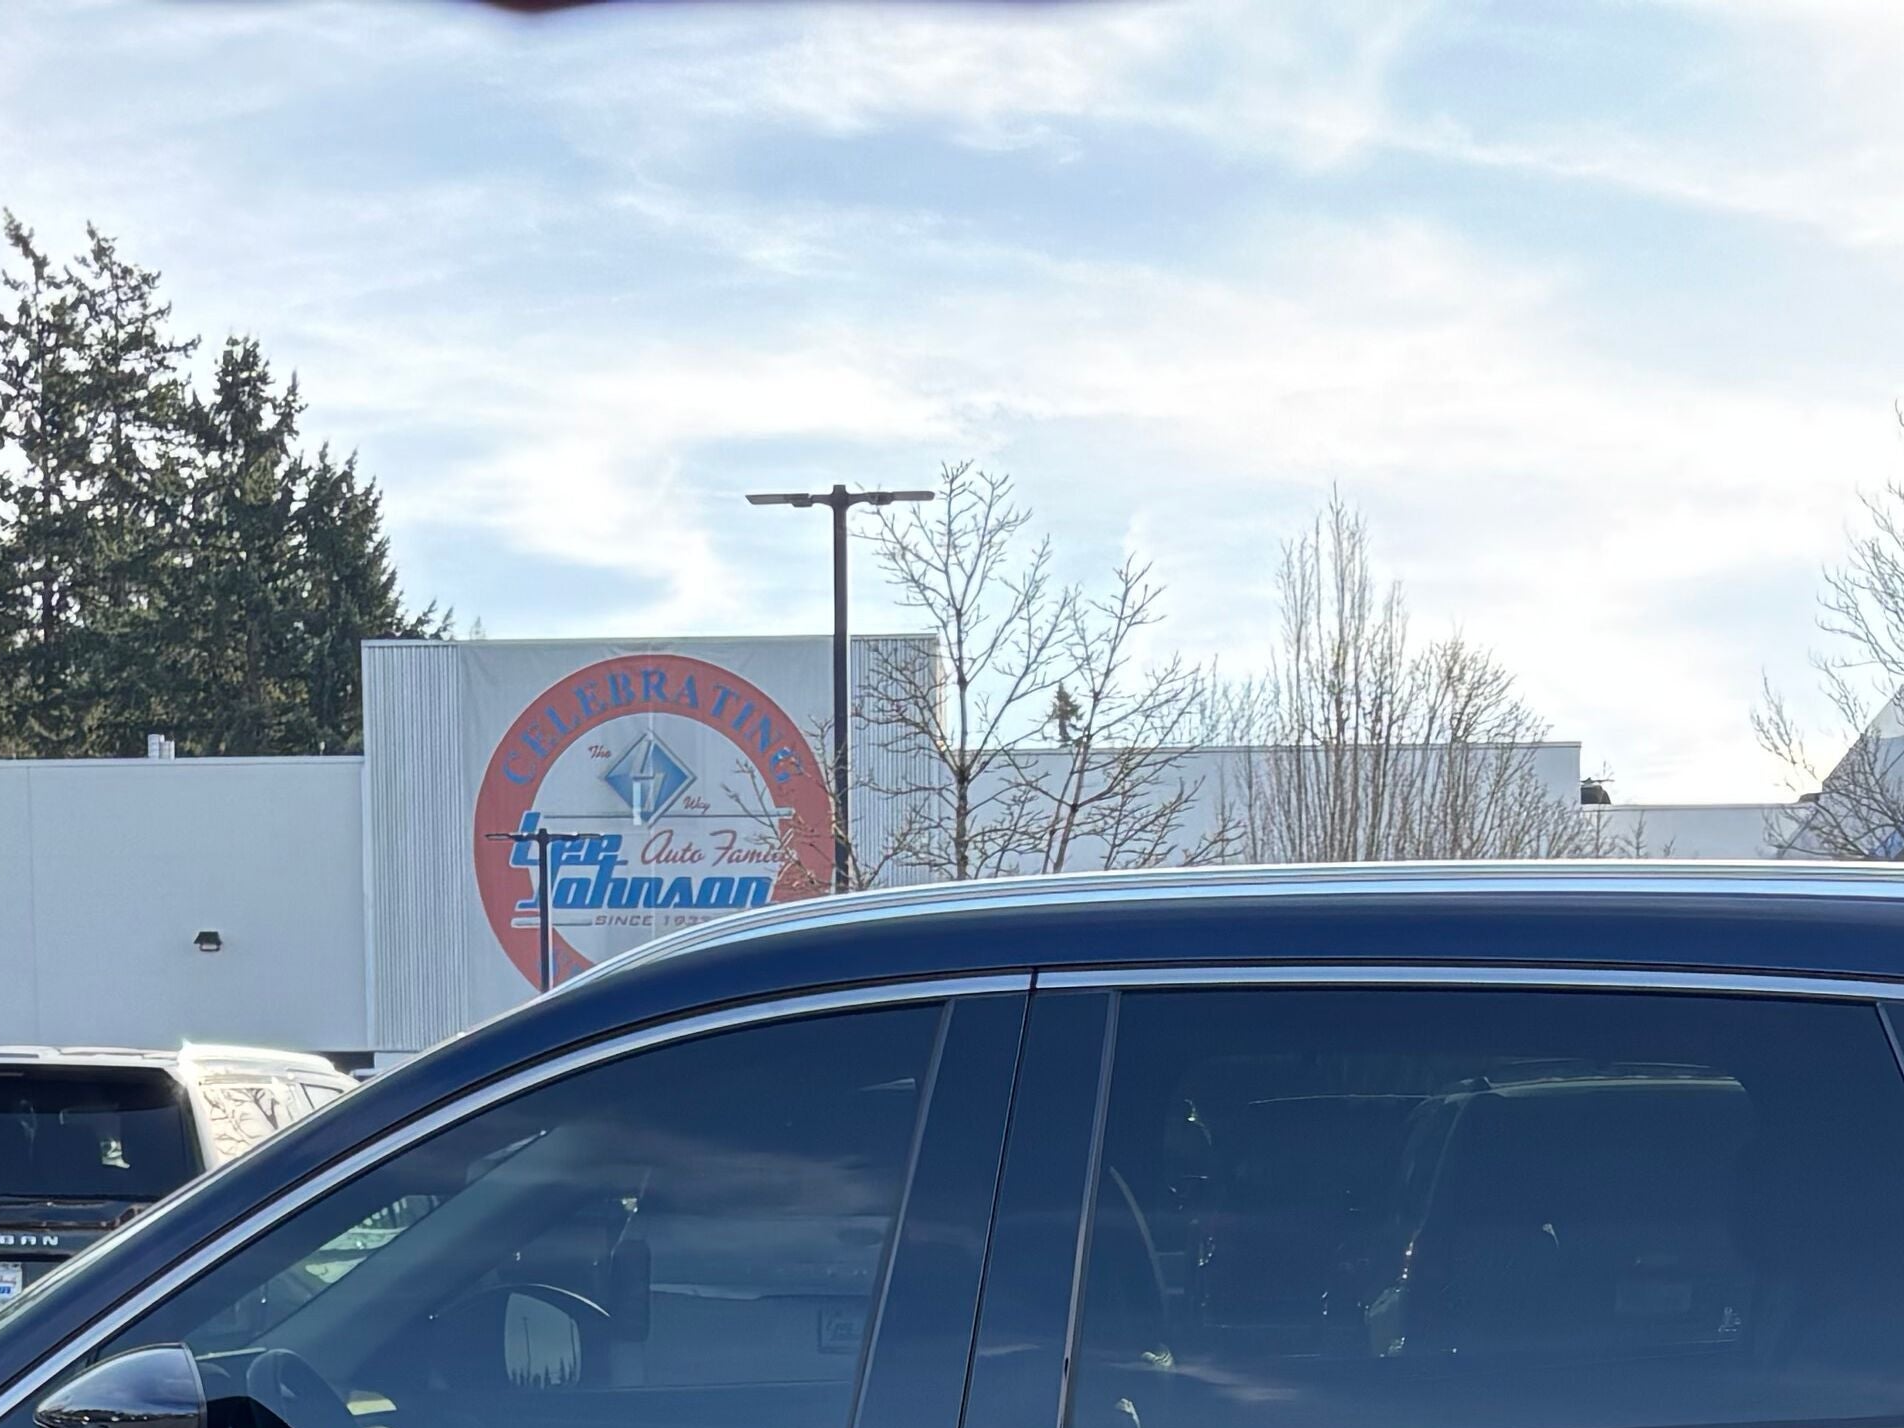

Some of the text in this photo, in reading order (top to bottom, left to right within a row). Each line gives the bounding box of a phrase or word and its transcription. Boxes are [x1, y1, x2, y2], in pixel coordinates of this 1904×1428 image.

[501, 667, 802, 786] CELEBRATING
[510, 811, 624, 867] Lee
[640, 829, 706, 865] Auto
[515, 860, 773, 910] Johnson
[595, 915, 653, 926] SINCE
